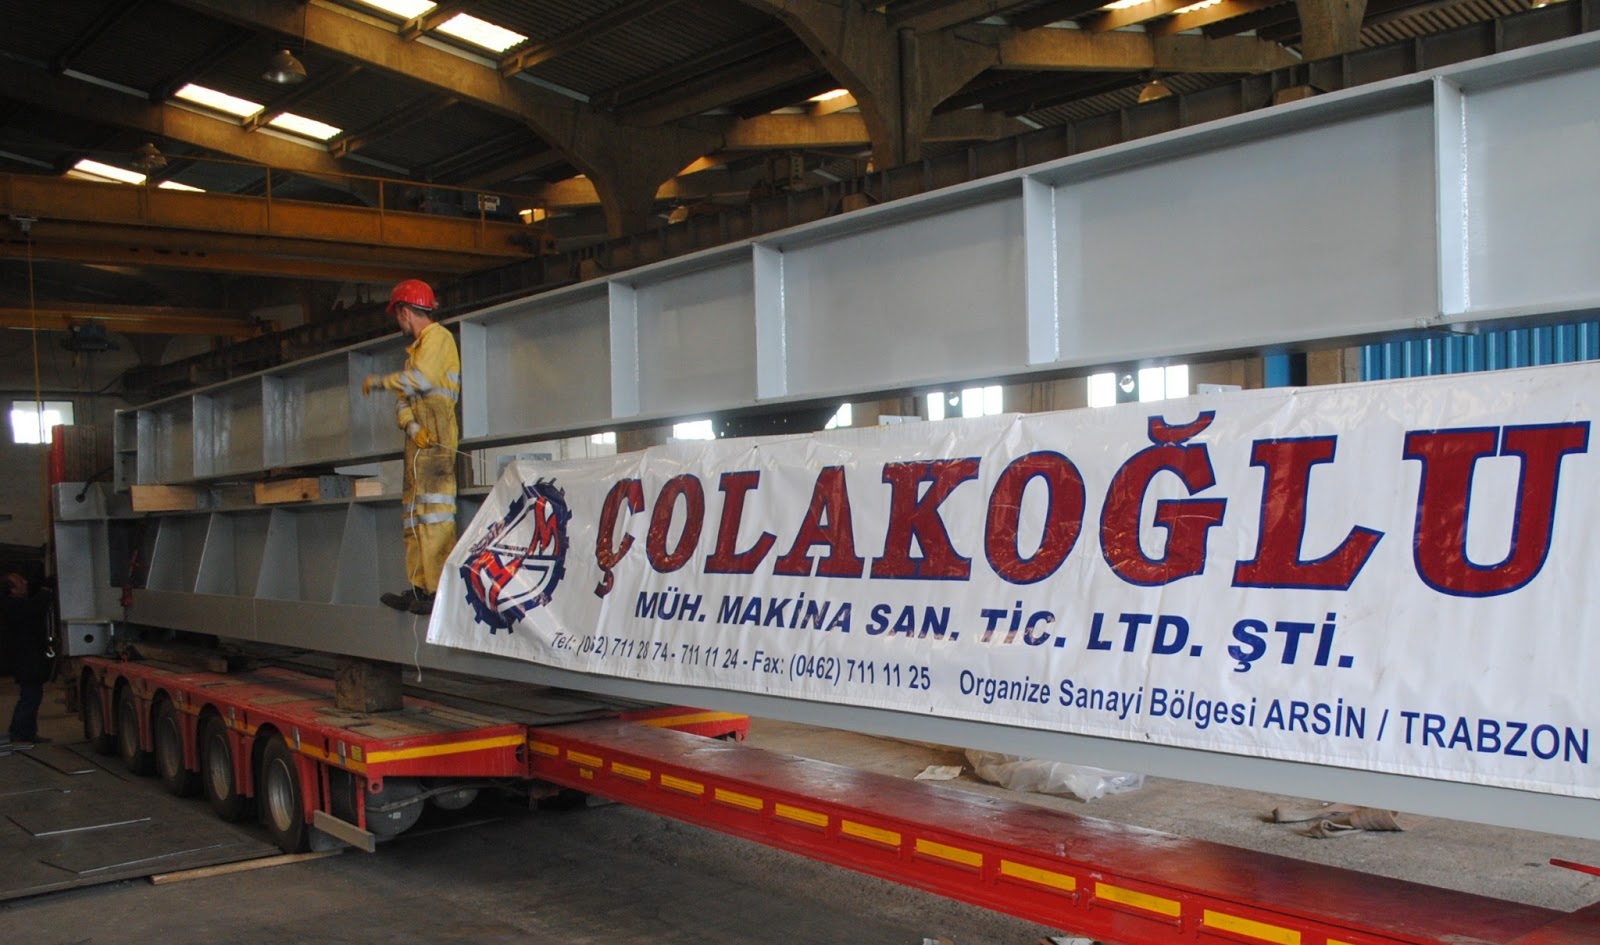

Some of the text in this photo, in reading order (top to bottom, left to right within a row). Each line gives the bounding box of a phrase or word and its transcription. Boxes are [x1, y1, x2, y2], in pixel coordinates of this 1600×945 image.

[594, 410, 1591, 599] ÇOLAKOĞLU
[635, 586, 1354, 672] MÜH. MAKİNA SAN. TİC. LTD. ŞTİ.
[551, 632, 572, 650] Tel:
[611, 638, 633, 658] 711
[652, 642, 668, 662] 74
[681, 645, 700, 666] 711
[705, 647, 718, 667] 11
[723, 649, 738, 669] 24
[752, 651, 784, 675] Fax:
[789, 654, 841, 686] (0462)
[847, 659, 875, 690] 711
[883, 662, 901, 687] 11
[908, 664, 931, 690] 25
[960, 669, 1050, 705] Organize
[1059, 679, 1144, 720] Sanayi
[1150, 688, 1256, 730] Bölgesi
[1263, 698, 1366, 740] ARSİN
[1377, 709, 1389, 742] /
[1400, 711, 1590, 764] TRABZON
